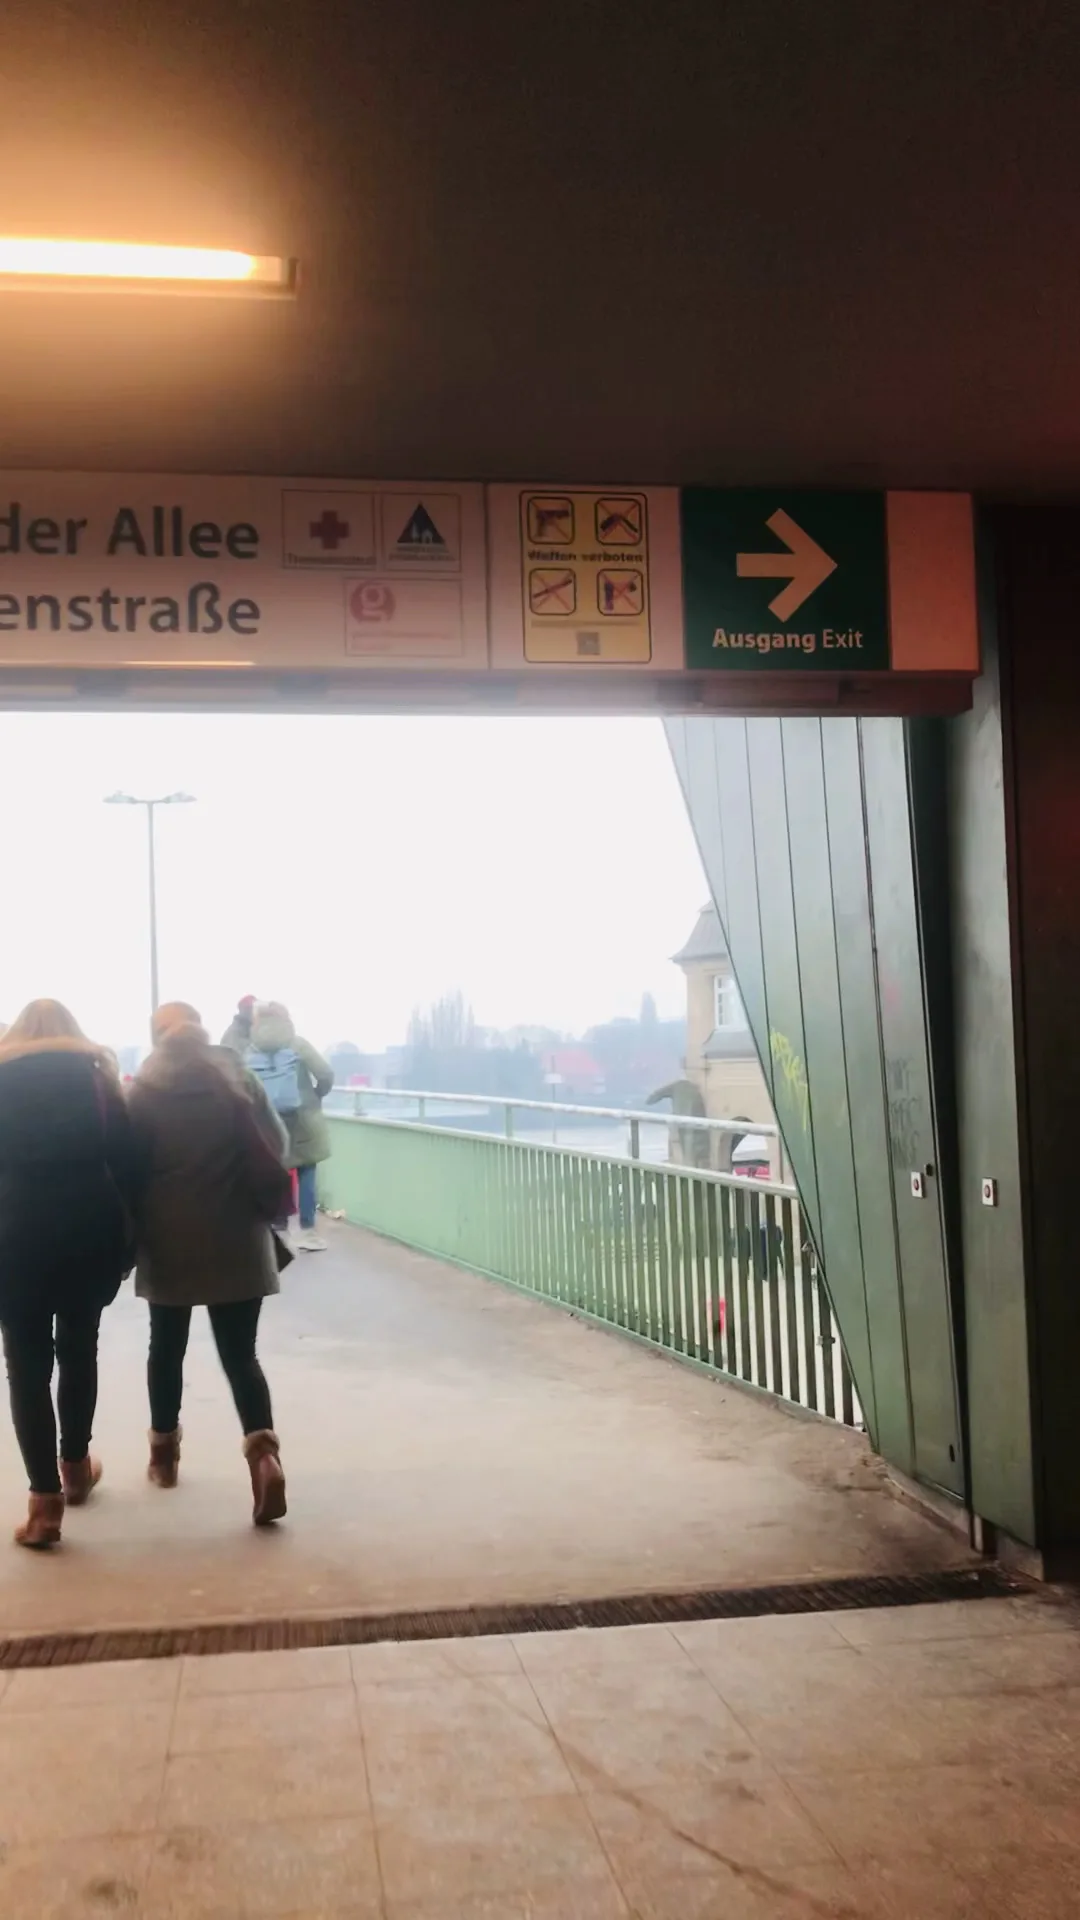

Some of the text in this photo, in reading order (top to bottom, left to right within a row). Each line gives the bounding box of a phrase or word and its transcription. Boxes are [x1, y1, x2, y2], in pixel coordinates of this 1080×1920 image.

[107, 506, 259, 559] Allee
[580, 550, 644, 563] verboten
[0, 582, 260, 635] enstraße
[712, 627, 864, 653] Ausgang Exit
